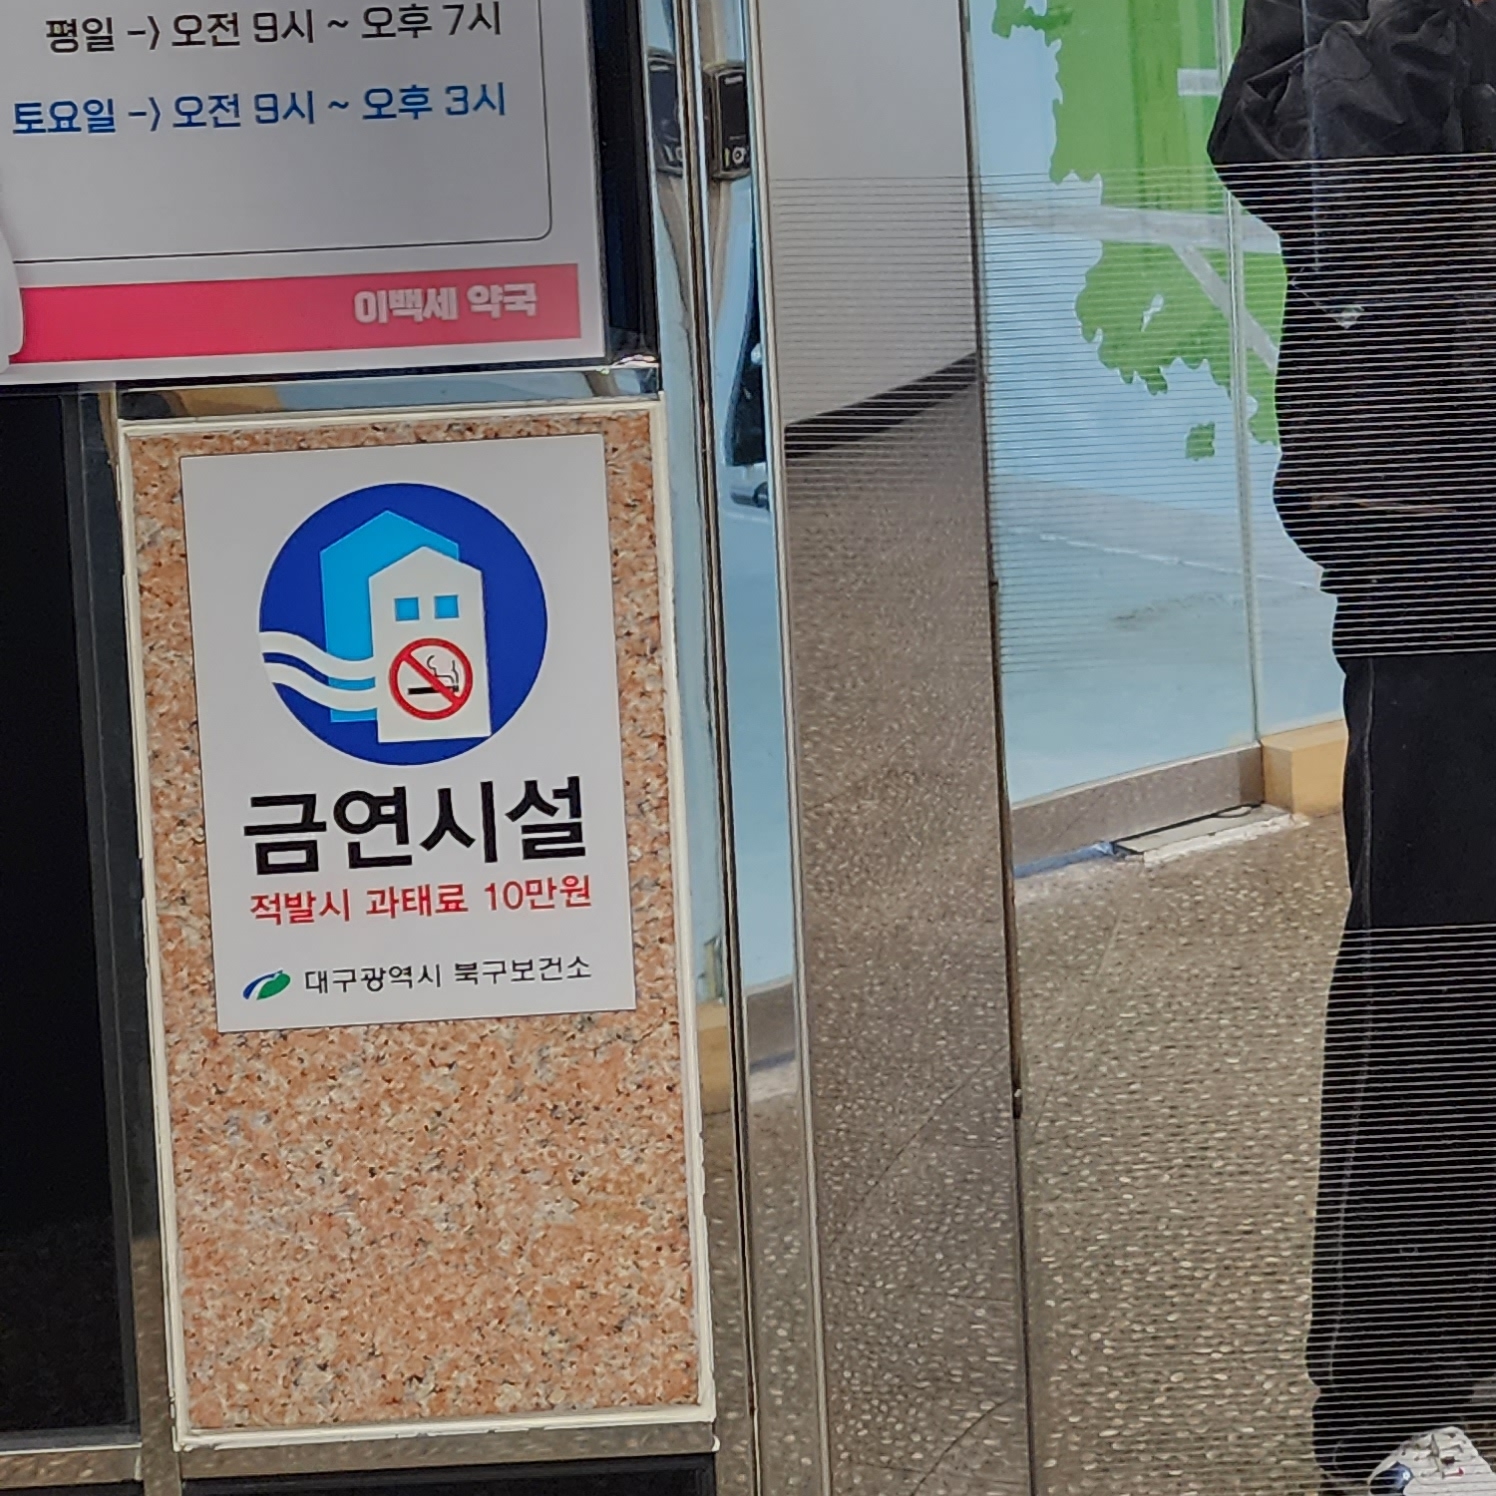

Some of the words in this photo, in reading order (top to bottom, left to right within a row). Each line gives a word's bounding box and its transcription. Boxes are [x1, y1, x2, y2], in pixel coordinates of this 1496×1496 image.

[46, 17, 114, 53] 평일
[172, 12, 240, 46] 오전
[254, 9, 313, 43] 9시
[362, 4, 432, 38] 오후
[443, 1, 500, 35] 7시
[13, 99, 115, 134] 토요일
[173, 94, 241, 128] 오전
[255, 91, 314, 124] 9시
[363, 85, 432, 119] 오후
[446, 82, 504, 115] 3시
[354, 287, 459, 324] 이백세
[467, 283, 537, 318] 약국
[244, 776, 586, 875] 금연시설
[251, 889, 349, 925] 적발시
[366, 884, 468, 919] 과태료
[485, 875, 591, 910] 10만원
[305, 965, 440, 993] 대구광역시
[455, 956, 591, 984] 북구보건소
